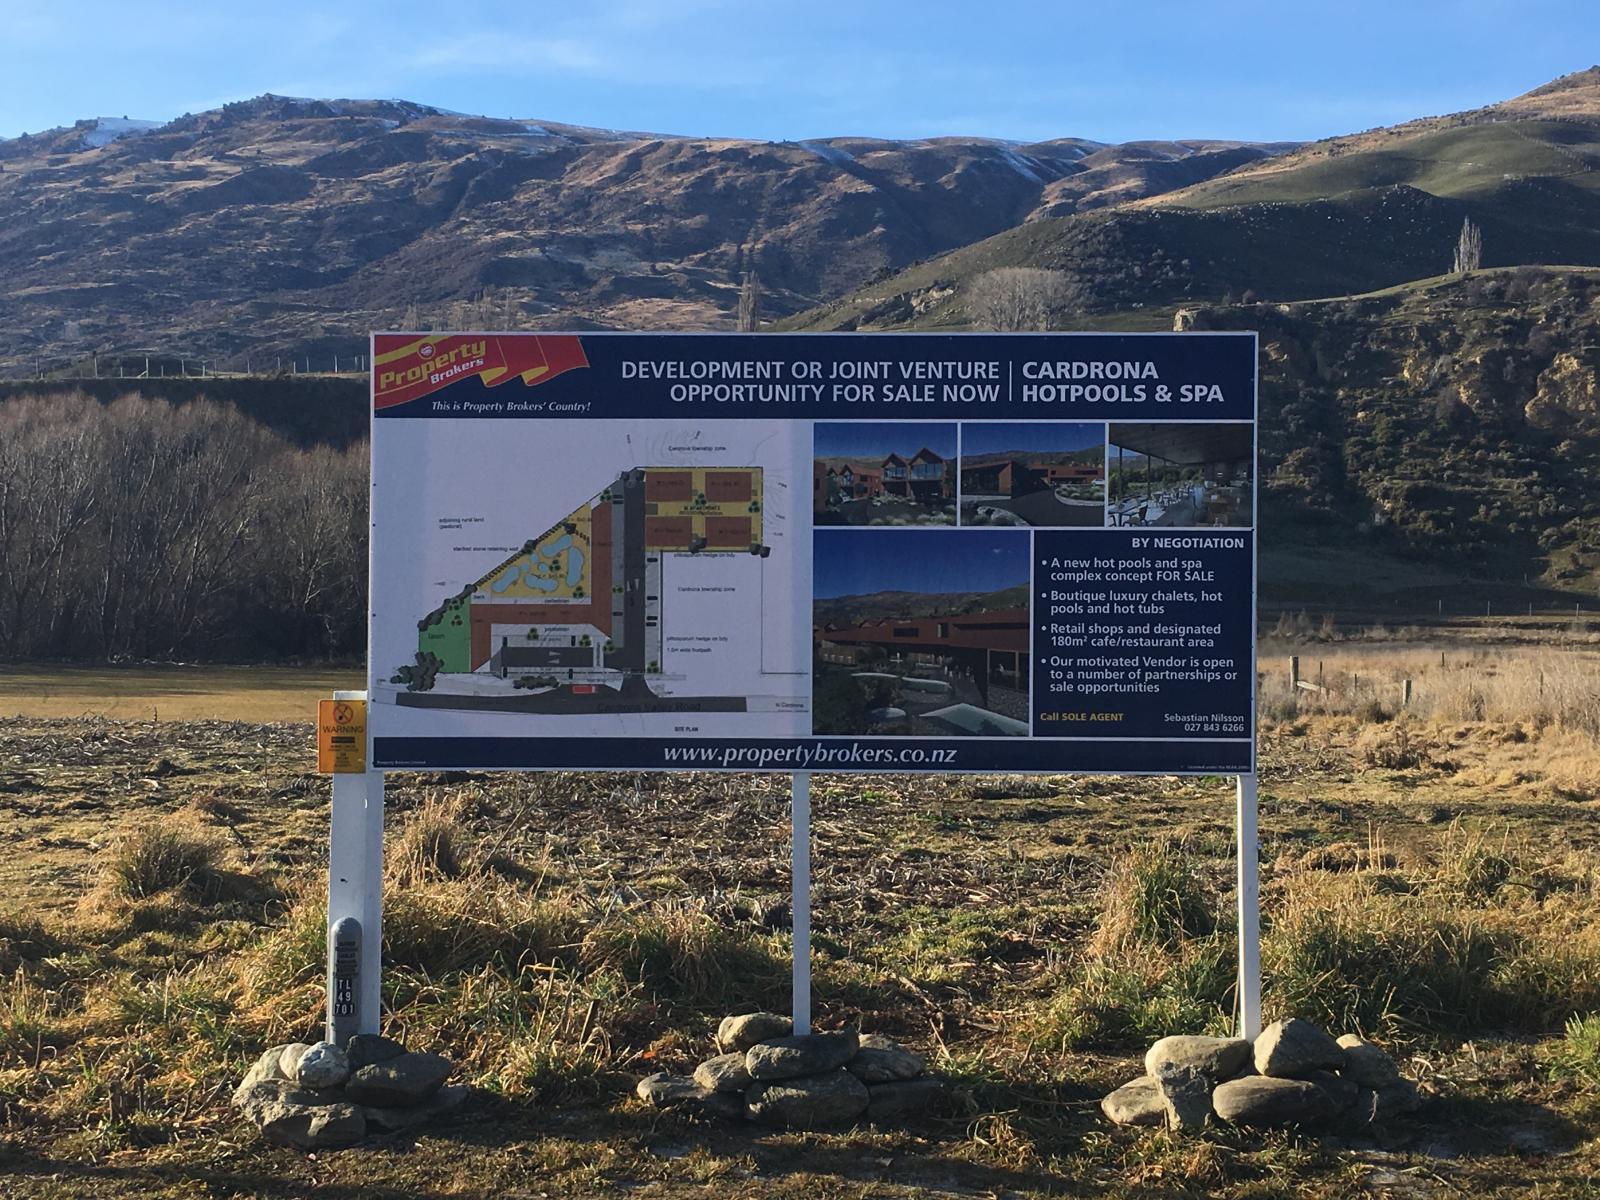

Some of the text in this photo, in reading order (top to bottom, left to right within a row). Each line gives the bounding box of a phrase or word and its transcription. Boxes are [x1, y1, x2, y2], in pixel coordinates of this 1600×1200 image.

[380, 340, 486, 389] Property
[430, 358, 484, 384] Brokers
[621, 361, 1000, 380] DEVELOPMENT OR JOINT VENTURE
[1022, 361, 1158, 380] CARDRONA
[670, 384, 1001, 402] OPPORTUNITY FOR SALE NOW
[1022, 384, 1225, 403] HOTPOOLS & SPA
[432, 401, 450, 411] This
[453, 401, 461, 411] is
[463, 401, 503, 414] Property
[549, 401, 591, 413] Country!
[1132, 537, 1244, 549] BY NEGOTIATION
[1050, 557, 1203, 571] A new hot pools and spa
[1050, 570, 1215, 583] complex concept FOR SALE
[1050, 590, 1223, 603] Boutique luxury chalets, hot
[1050, 603, 1165, 616] pools and hot tubs
[1050, 622, 1221, 637] Retail shops and designated
[1090, 635, 1185, 648] cafe/restaurant
[1187, 638, 1214, 648] area
[1050, 655, 1234, 670] Our motivated Vendor is open
[1050, 668, 1238, 683] to a number of partnerships or
[1049, 680, 1160, 695] sale opportunities
[1040, 712, 1124, 722] Call SOLE AGENT
[1164, 712, 1245, 723] Sebastian Nilsson
[322, 725, 364, 733] WARNING
[1184, 723, 1245, 732] 027 843 6266
[663, 743, 958, 767] www.propertybrokers.co.nz
[338, 991, 351, 1002] 49
[335, 1003, 354, 1014] 701
